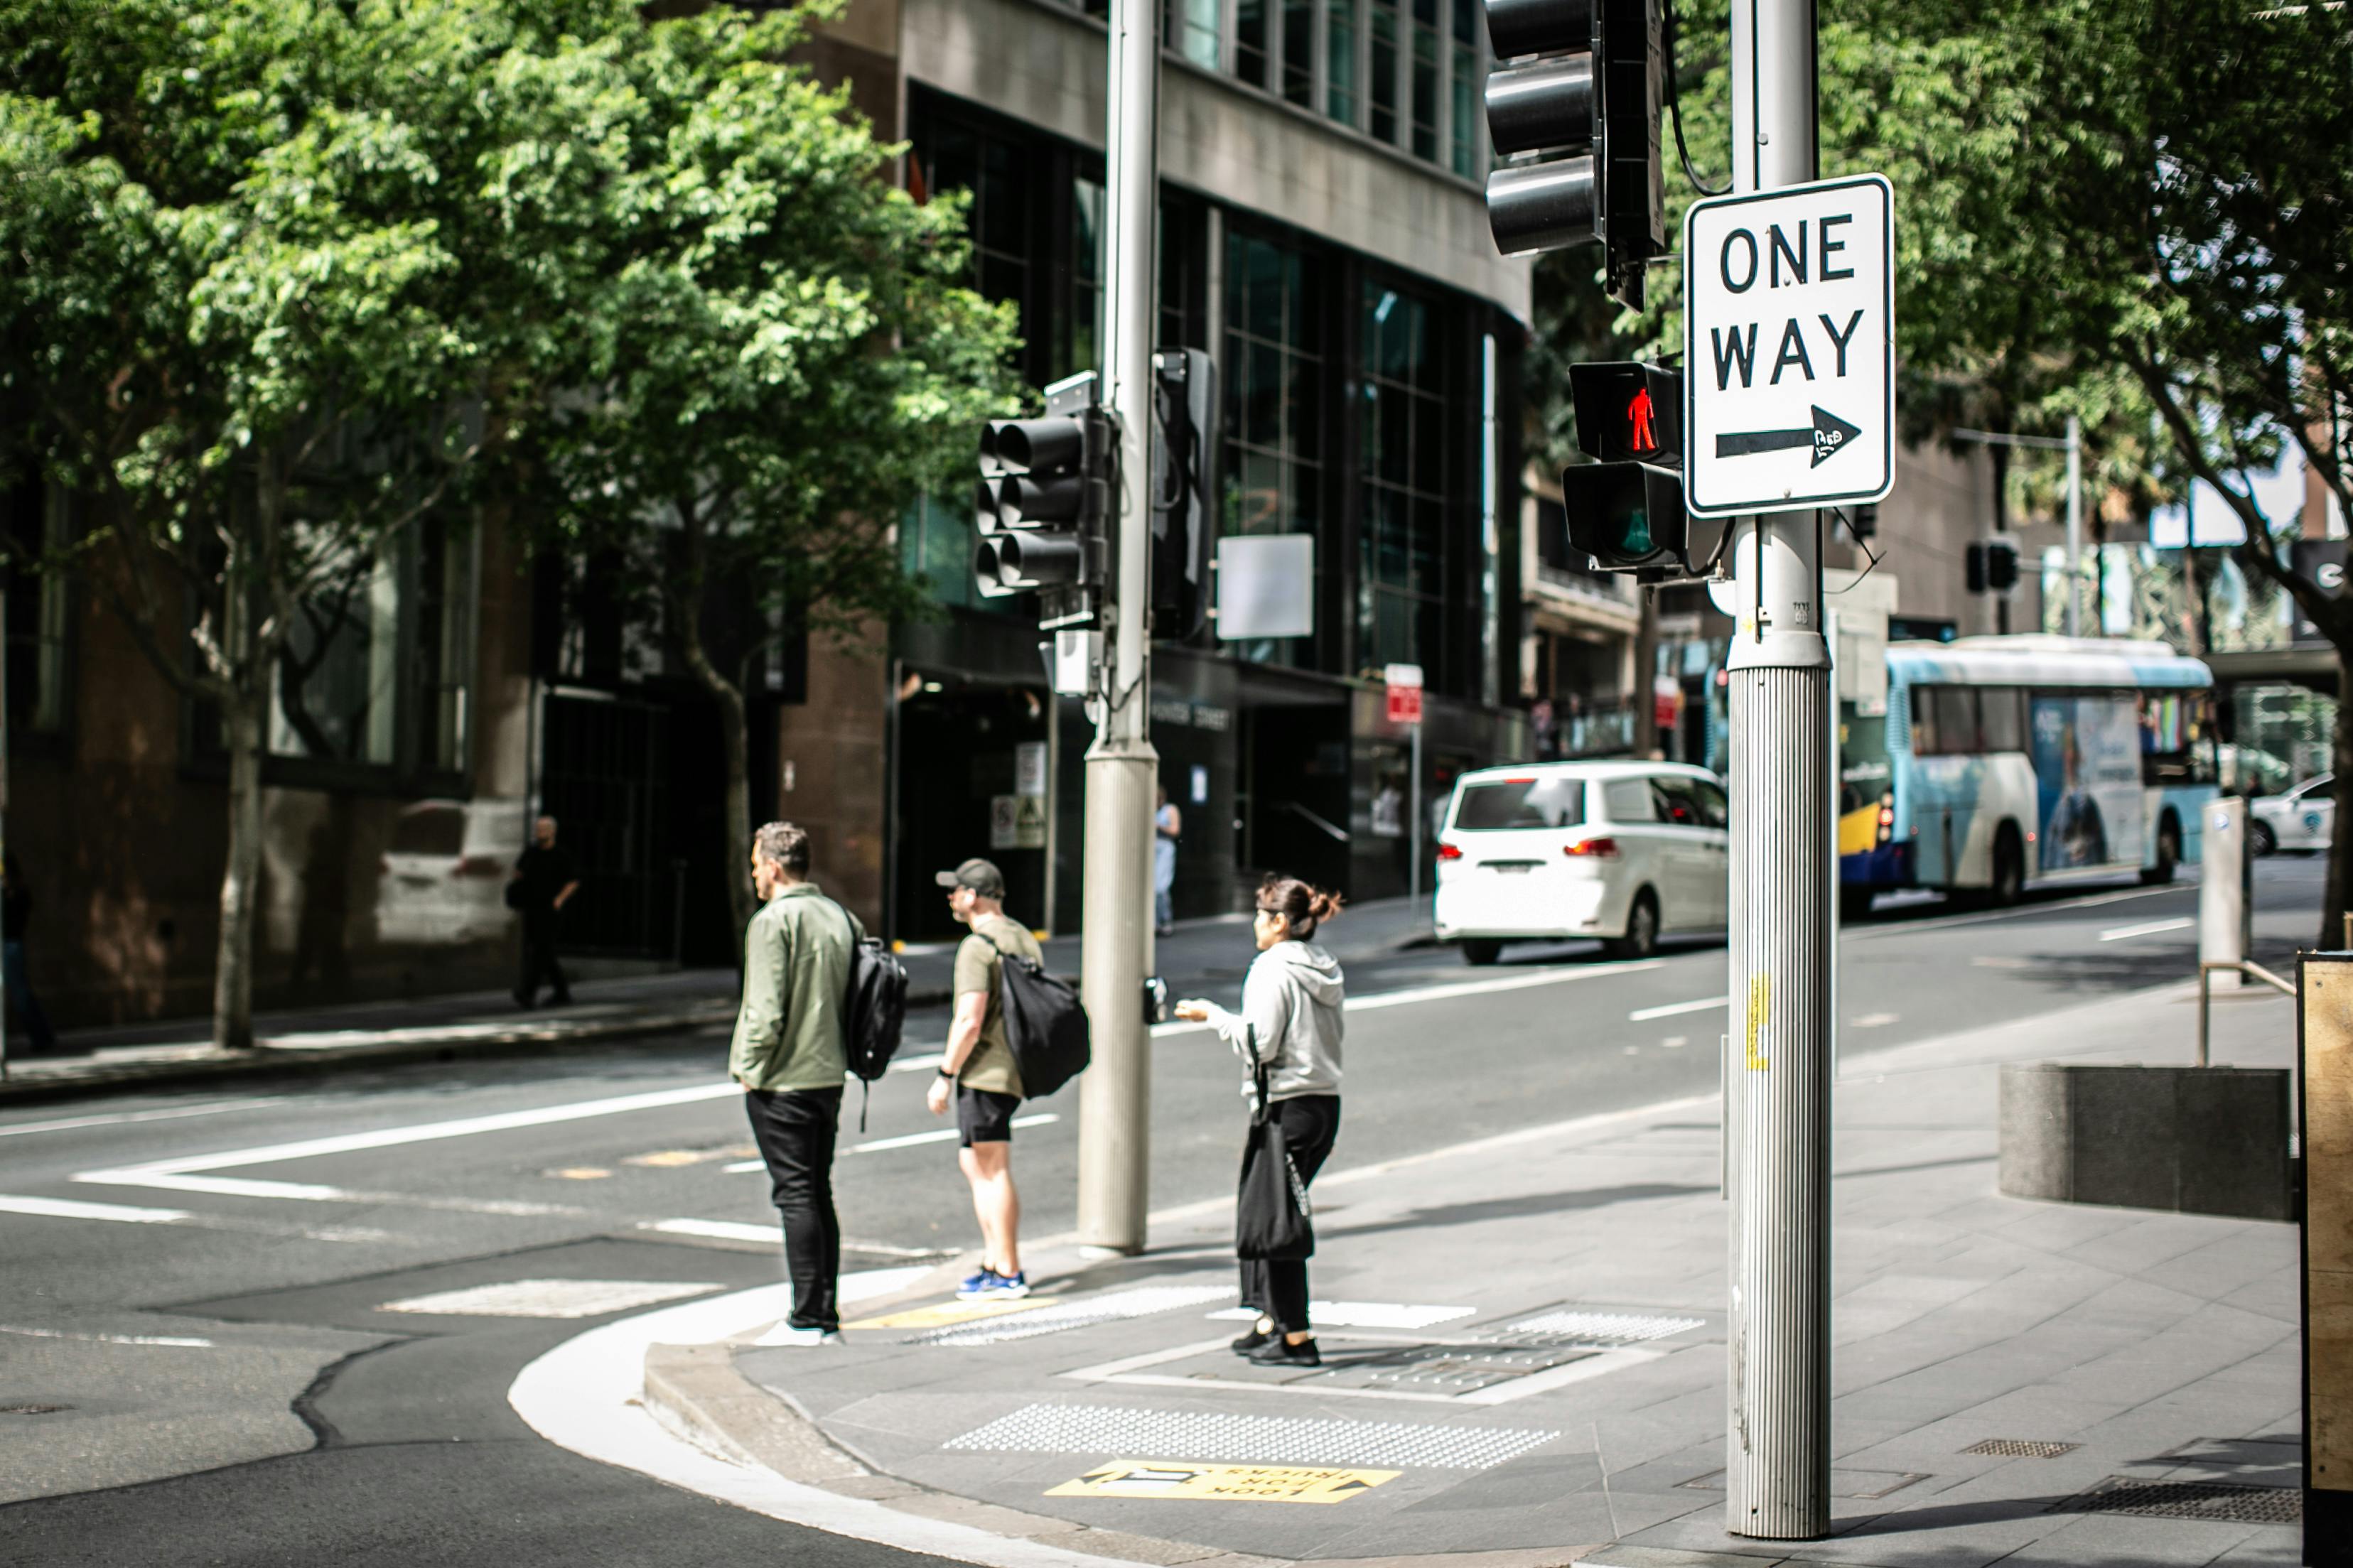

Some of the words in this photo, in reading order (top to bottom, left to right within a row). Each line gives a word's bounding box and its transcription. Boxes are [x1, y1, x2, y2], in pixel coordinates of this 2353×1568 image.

[1720, 213, 1855, 294] ONE
[1711, 308, 1865, 391] WAY
[1210, 1487, 1305, 1496] LOOK
[1239, 1478, 1310, 1486] FOR
